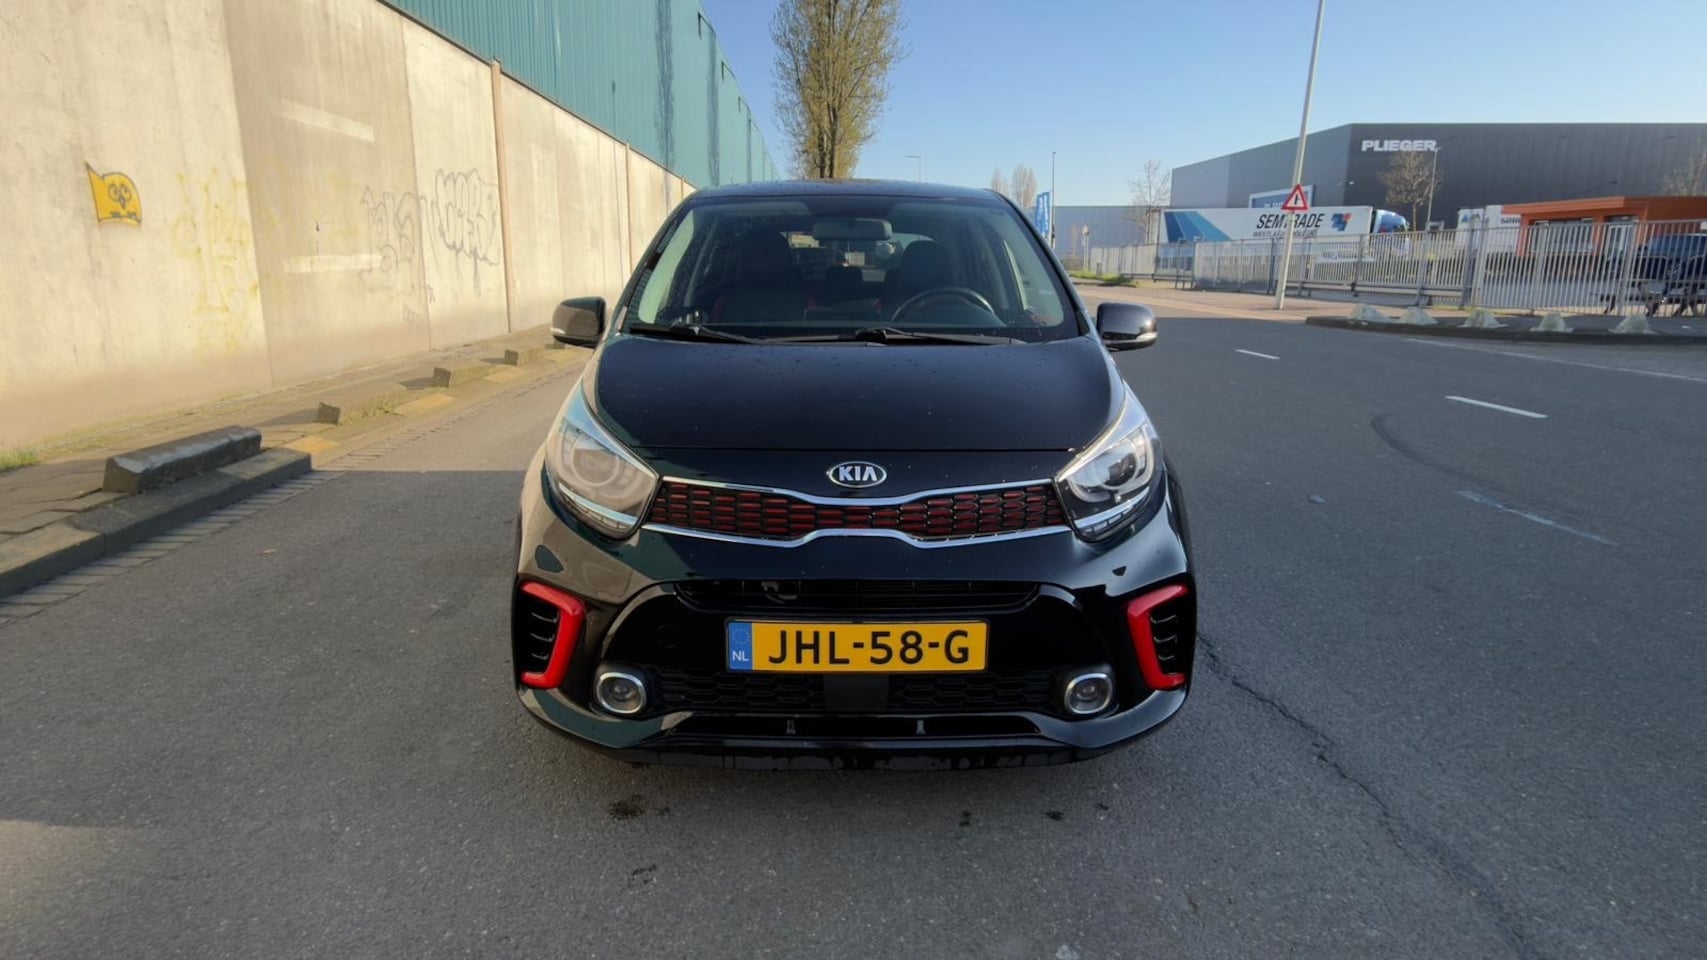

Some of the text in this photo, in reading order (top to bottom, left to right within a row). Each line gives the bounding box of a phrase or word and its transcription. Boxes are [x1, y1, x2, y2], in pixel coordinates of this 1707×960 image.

[1361, 139, 1437, 152] PLIEGER
[839, 466, 878, 481] KIA
[768, 629, 970, 665] JHL-58-G
[732, 651, 749, 662] NL
